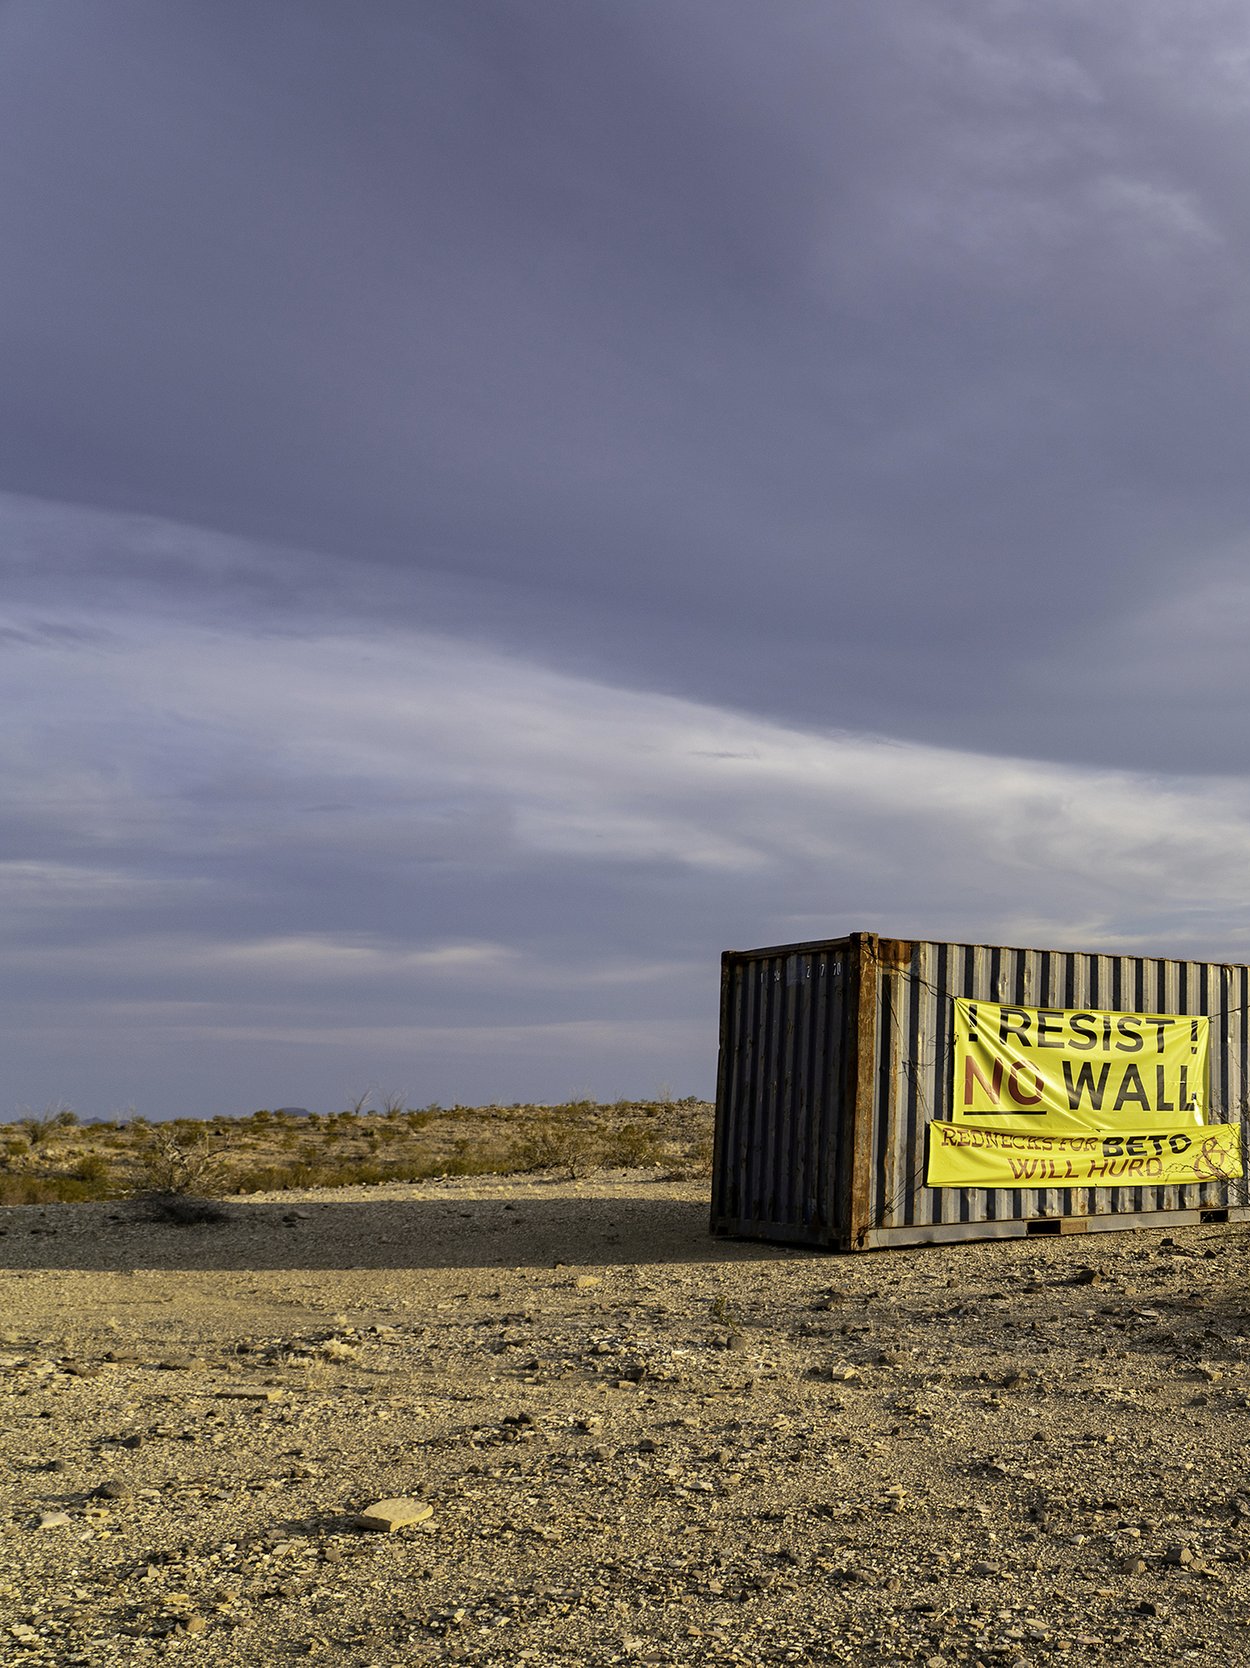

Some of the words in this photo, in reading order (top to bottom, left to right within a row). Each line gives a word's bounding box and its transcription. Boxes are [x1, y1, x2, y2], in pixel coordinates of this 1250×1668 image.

[999, 1006, 1176, 1054] RESIST
[963, 1055, 1045, 1106] NO
[1062, 1060, 1196, 1112] WALL
[941, 1127, 1054, 1152] REDNECKS
[1056, 1136, 1099, 1152] FOR
[1102, 1132, 1193, 1158] BETO
[1006, 1157, 1081, 1181] WILL
[1086, 1156, 1164, 1179] HURD
